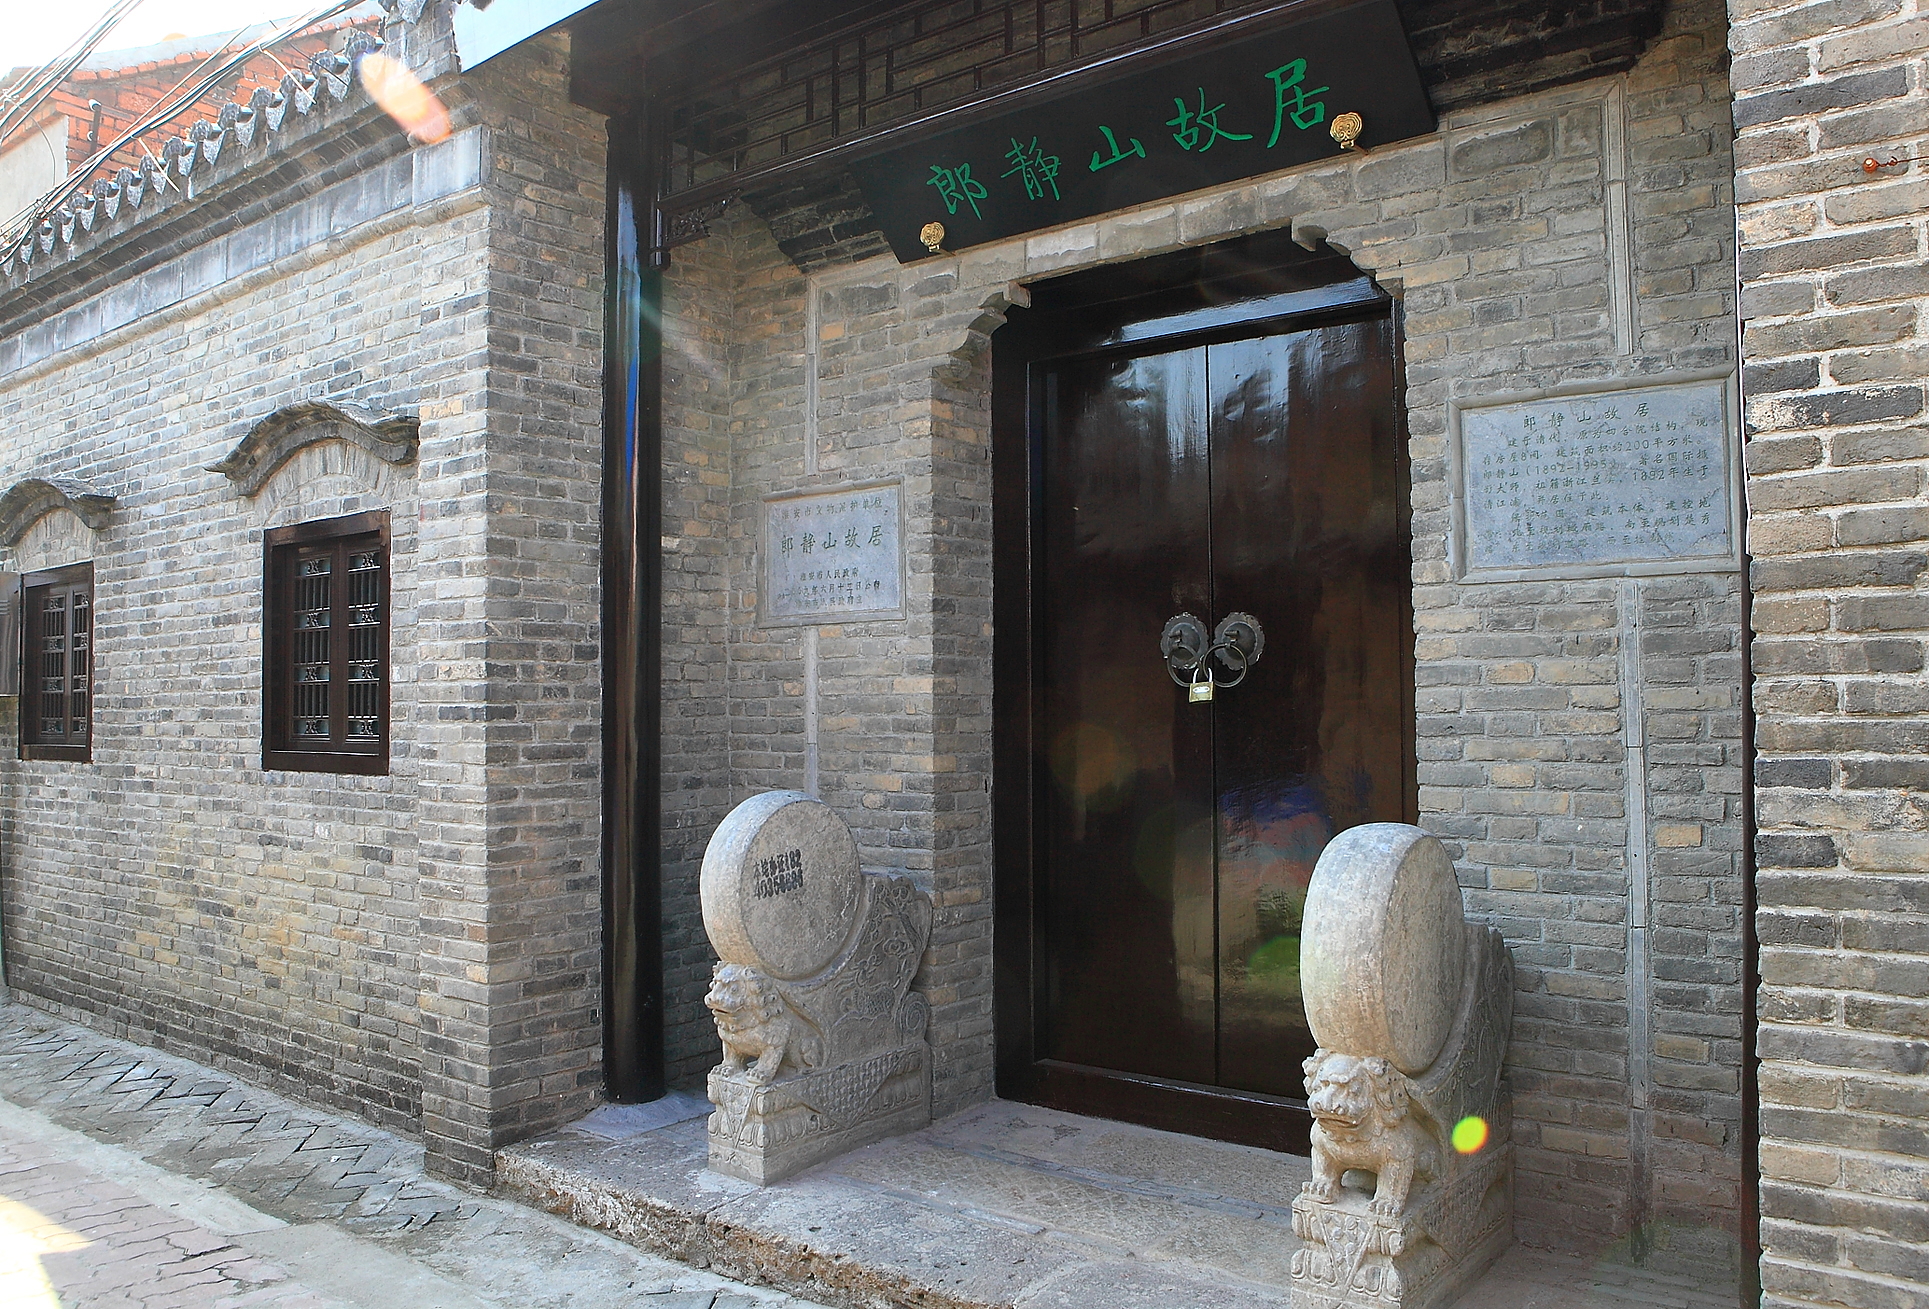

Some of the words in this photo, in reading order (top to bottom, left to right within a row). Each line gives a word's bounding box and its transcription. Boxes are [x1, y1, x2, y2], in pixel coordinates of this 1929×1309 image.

[926, 57, 1330, 220] 郎静山故居
[1523, 402, 1649, 429] 郎静山故居
[780, 525, 883, 558] 郎静山故居
